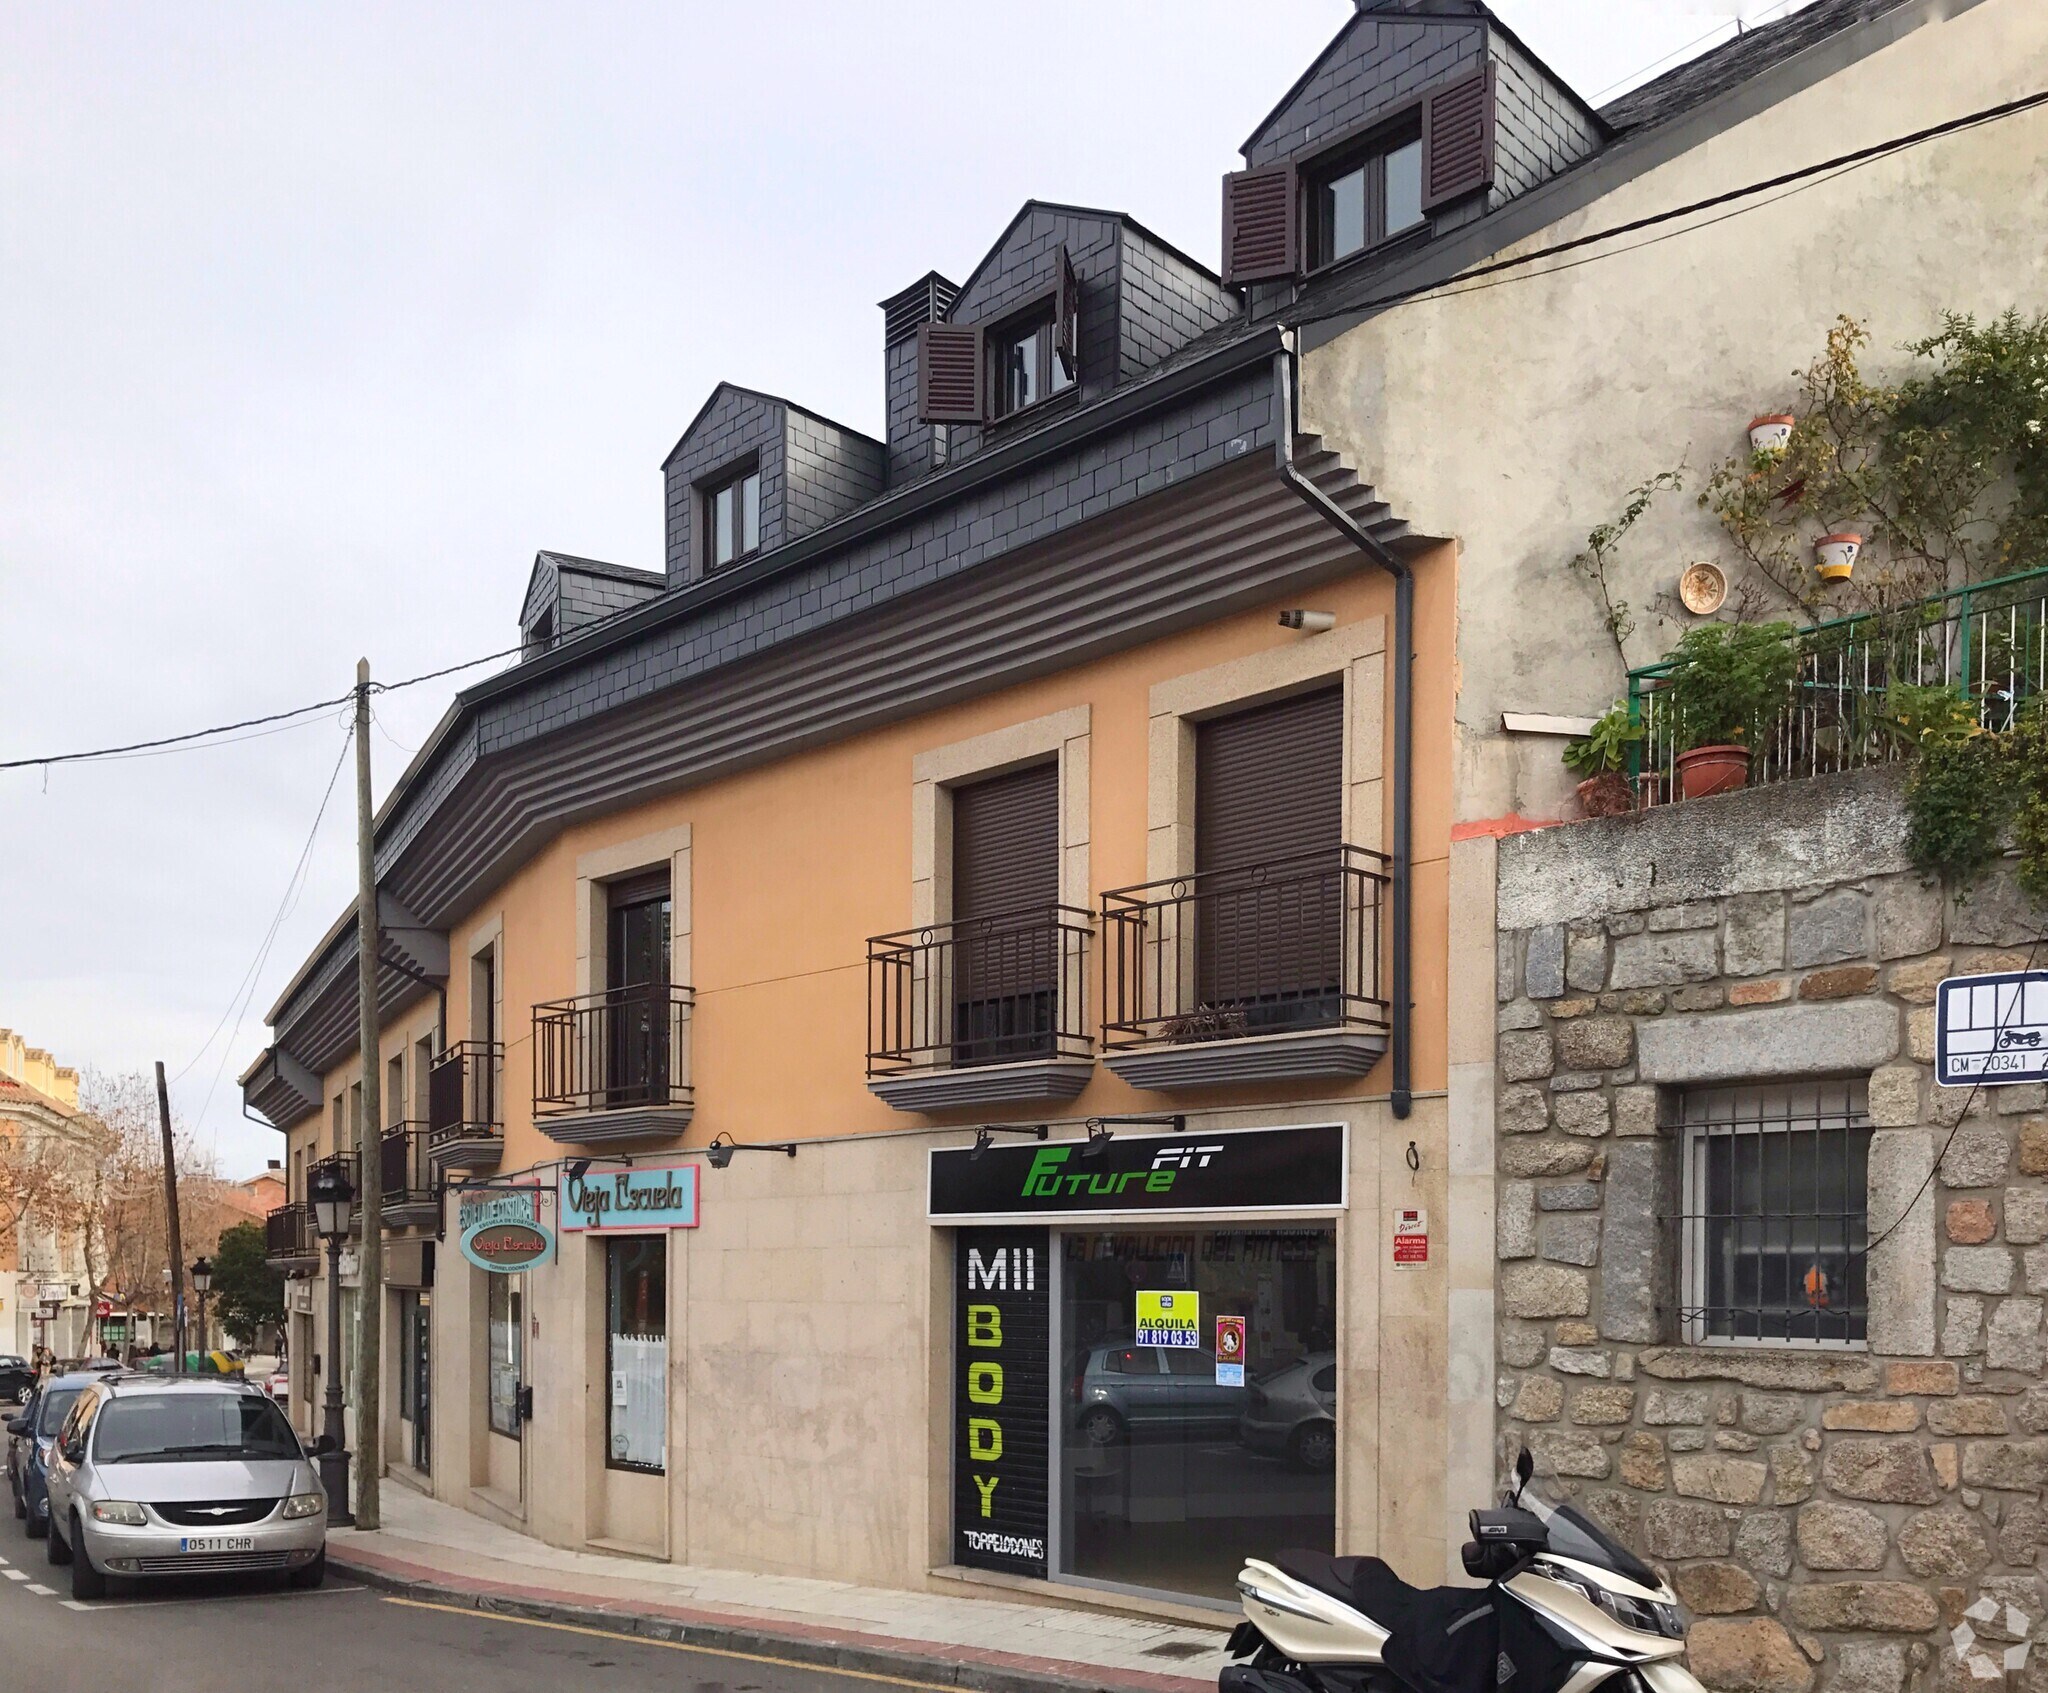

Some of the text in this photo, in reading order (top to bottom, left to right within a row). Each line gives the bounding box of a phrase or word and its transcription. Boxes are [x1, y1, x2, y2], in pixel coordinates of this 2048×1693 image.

[568, 1171, 683, 1228] Vieja Escuela
[478, 1218, 503, 1229] ESCUELA
[513, 1218, 537, 1229] COSTURA
[473, 1236, 544, 1256] Vieja Escuela
[1395, 1236, 1426, 1245] Alarma
[1140, 1318, 1195, 1329] ALQUILA
[1138, 1329, 1197, 1346] 91 819 03 53
[189, 1537, 252, 1551] 0511 CHR
